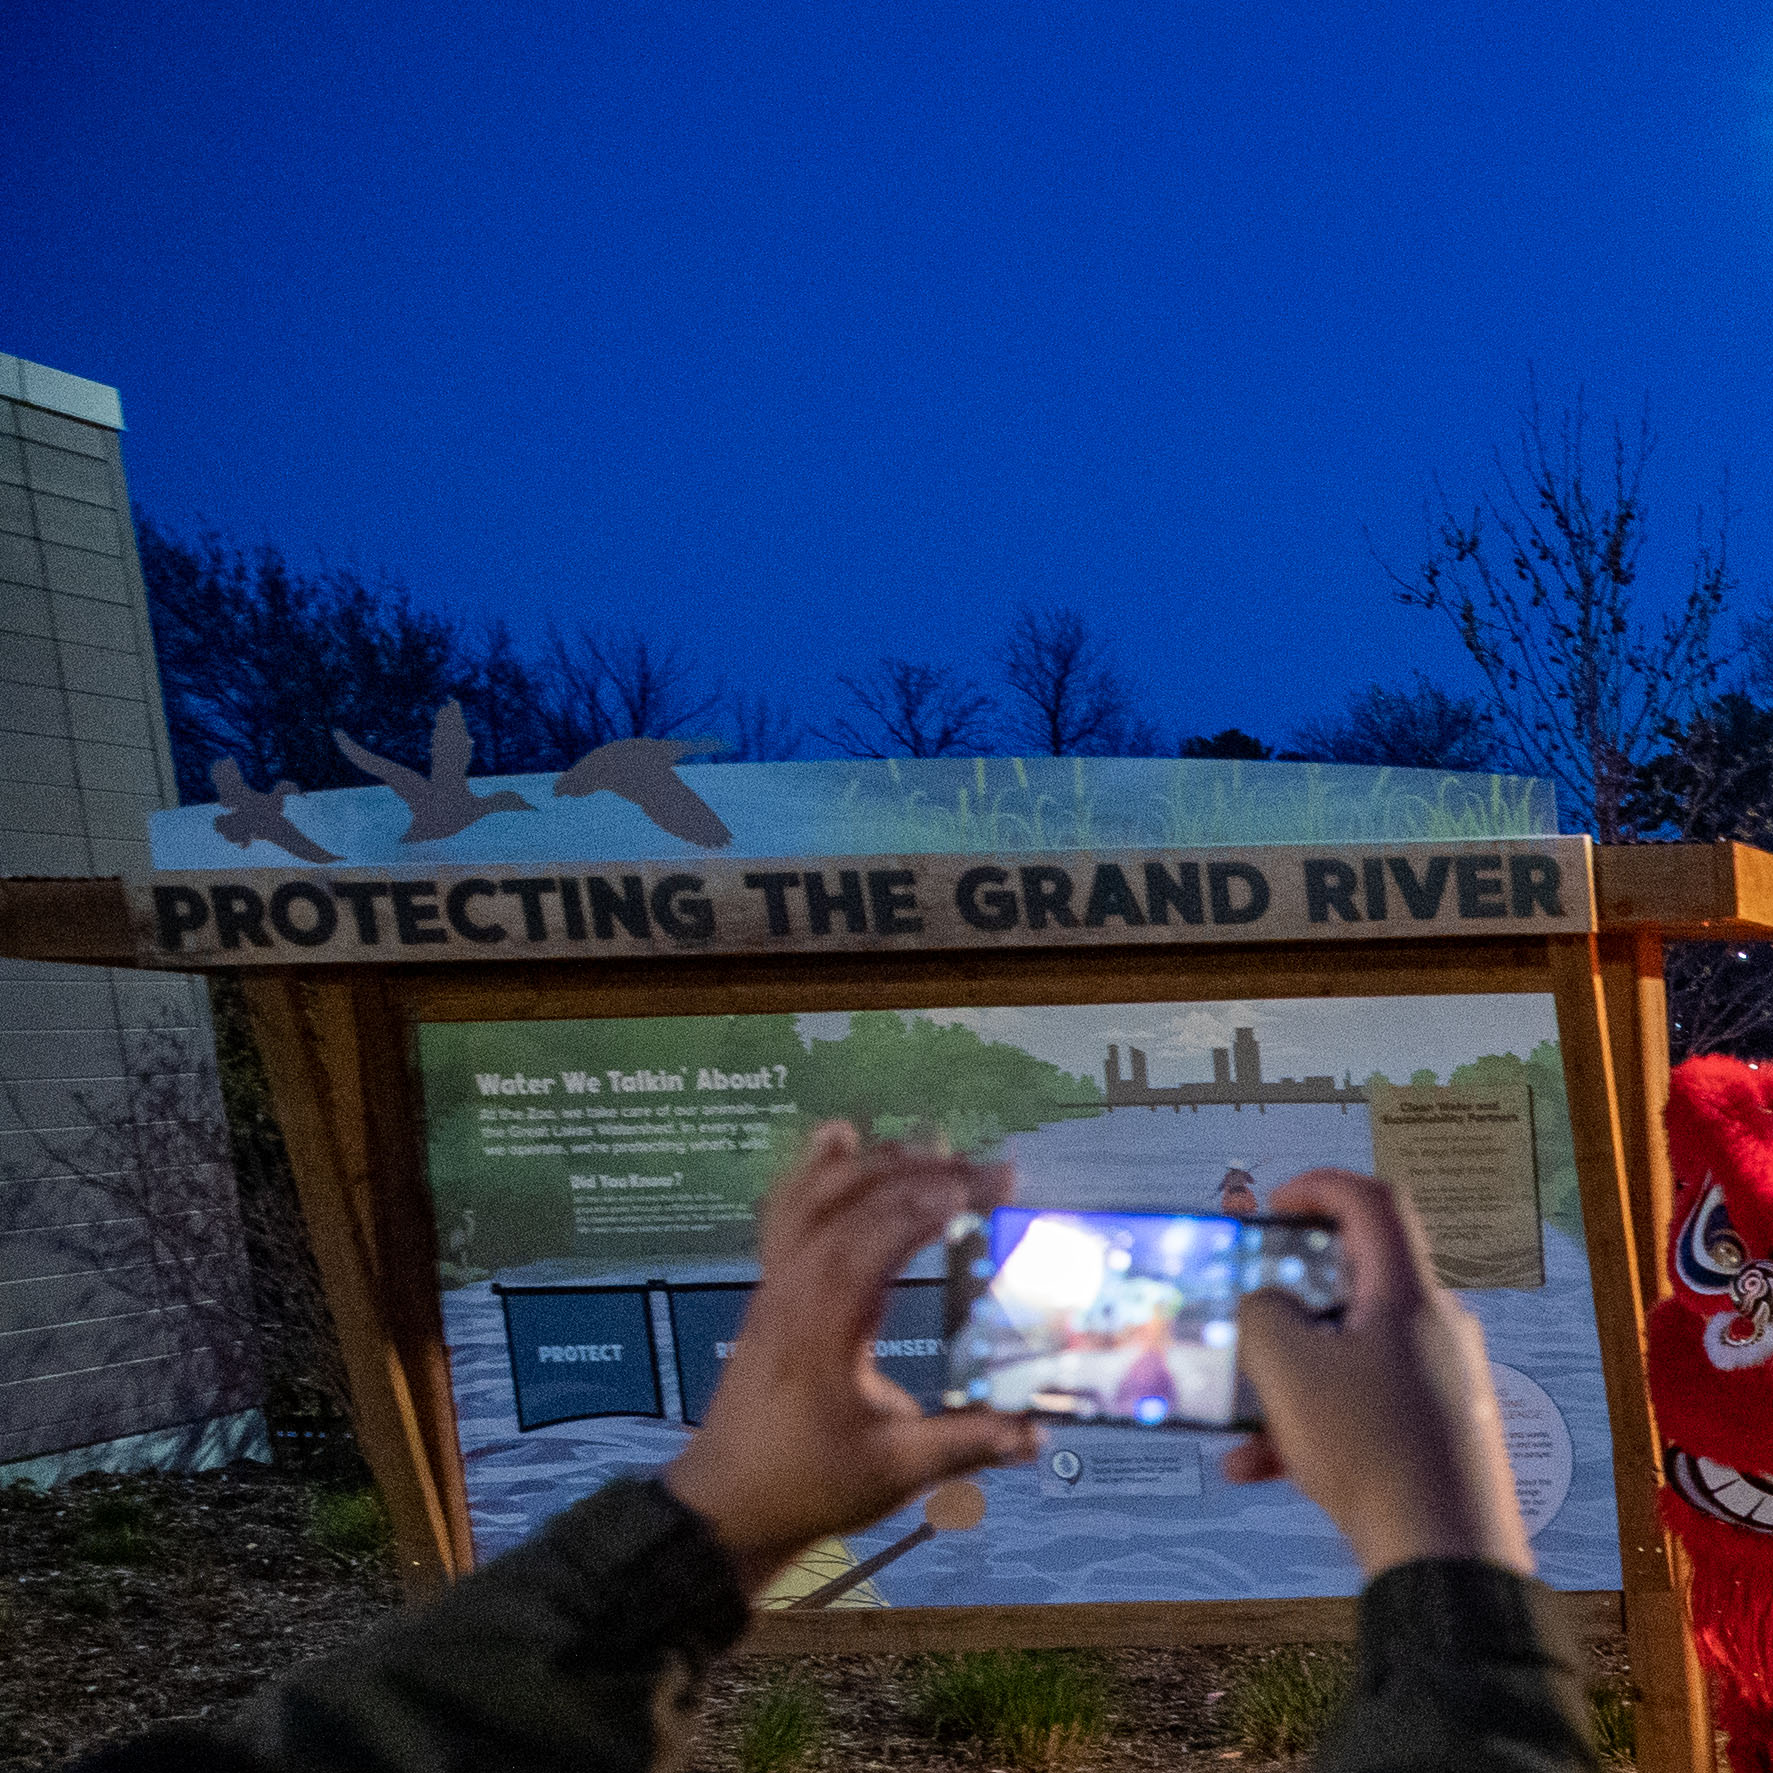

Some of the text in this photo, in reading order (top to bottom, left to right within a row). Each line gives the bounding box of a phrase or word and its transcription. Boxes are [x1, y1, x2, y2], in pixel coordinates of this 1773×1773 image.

[152, 854, 1568, 952] PROTECTING THE GRAND RIVER
[475, 1073, 555, 1095] Water
[560, 1070, 601, 1093] We
[696, 1064, 788, 1090] About?
[570, 1174, 597, 1189] Did
[600, 1174, 627, 1188] You
[538, 1343, 623, 1363] PROTECT
[870, 1338, 943, 1357] ONSER
